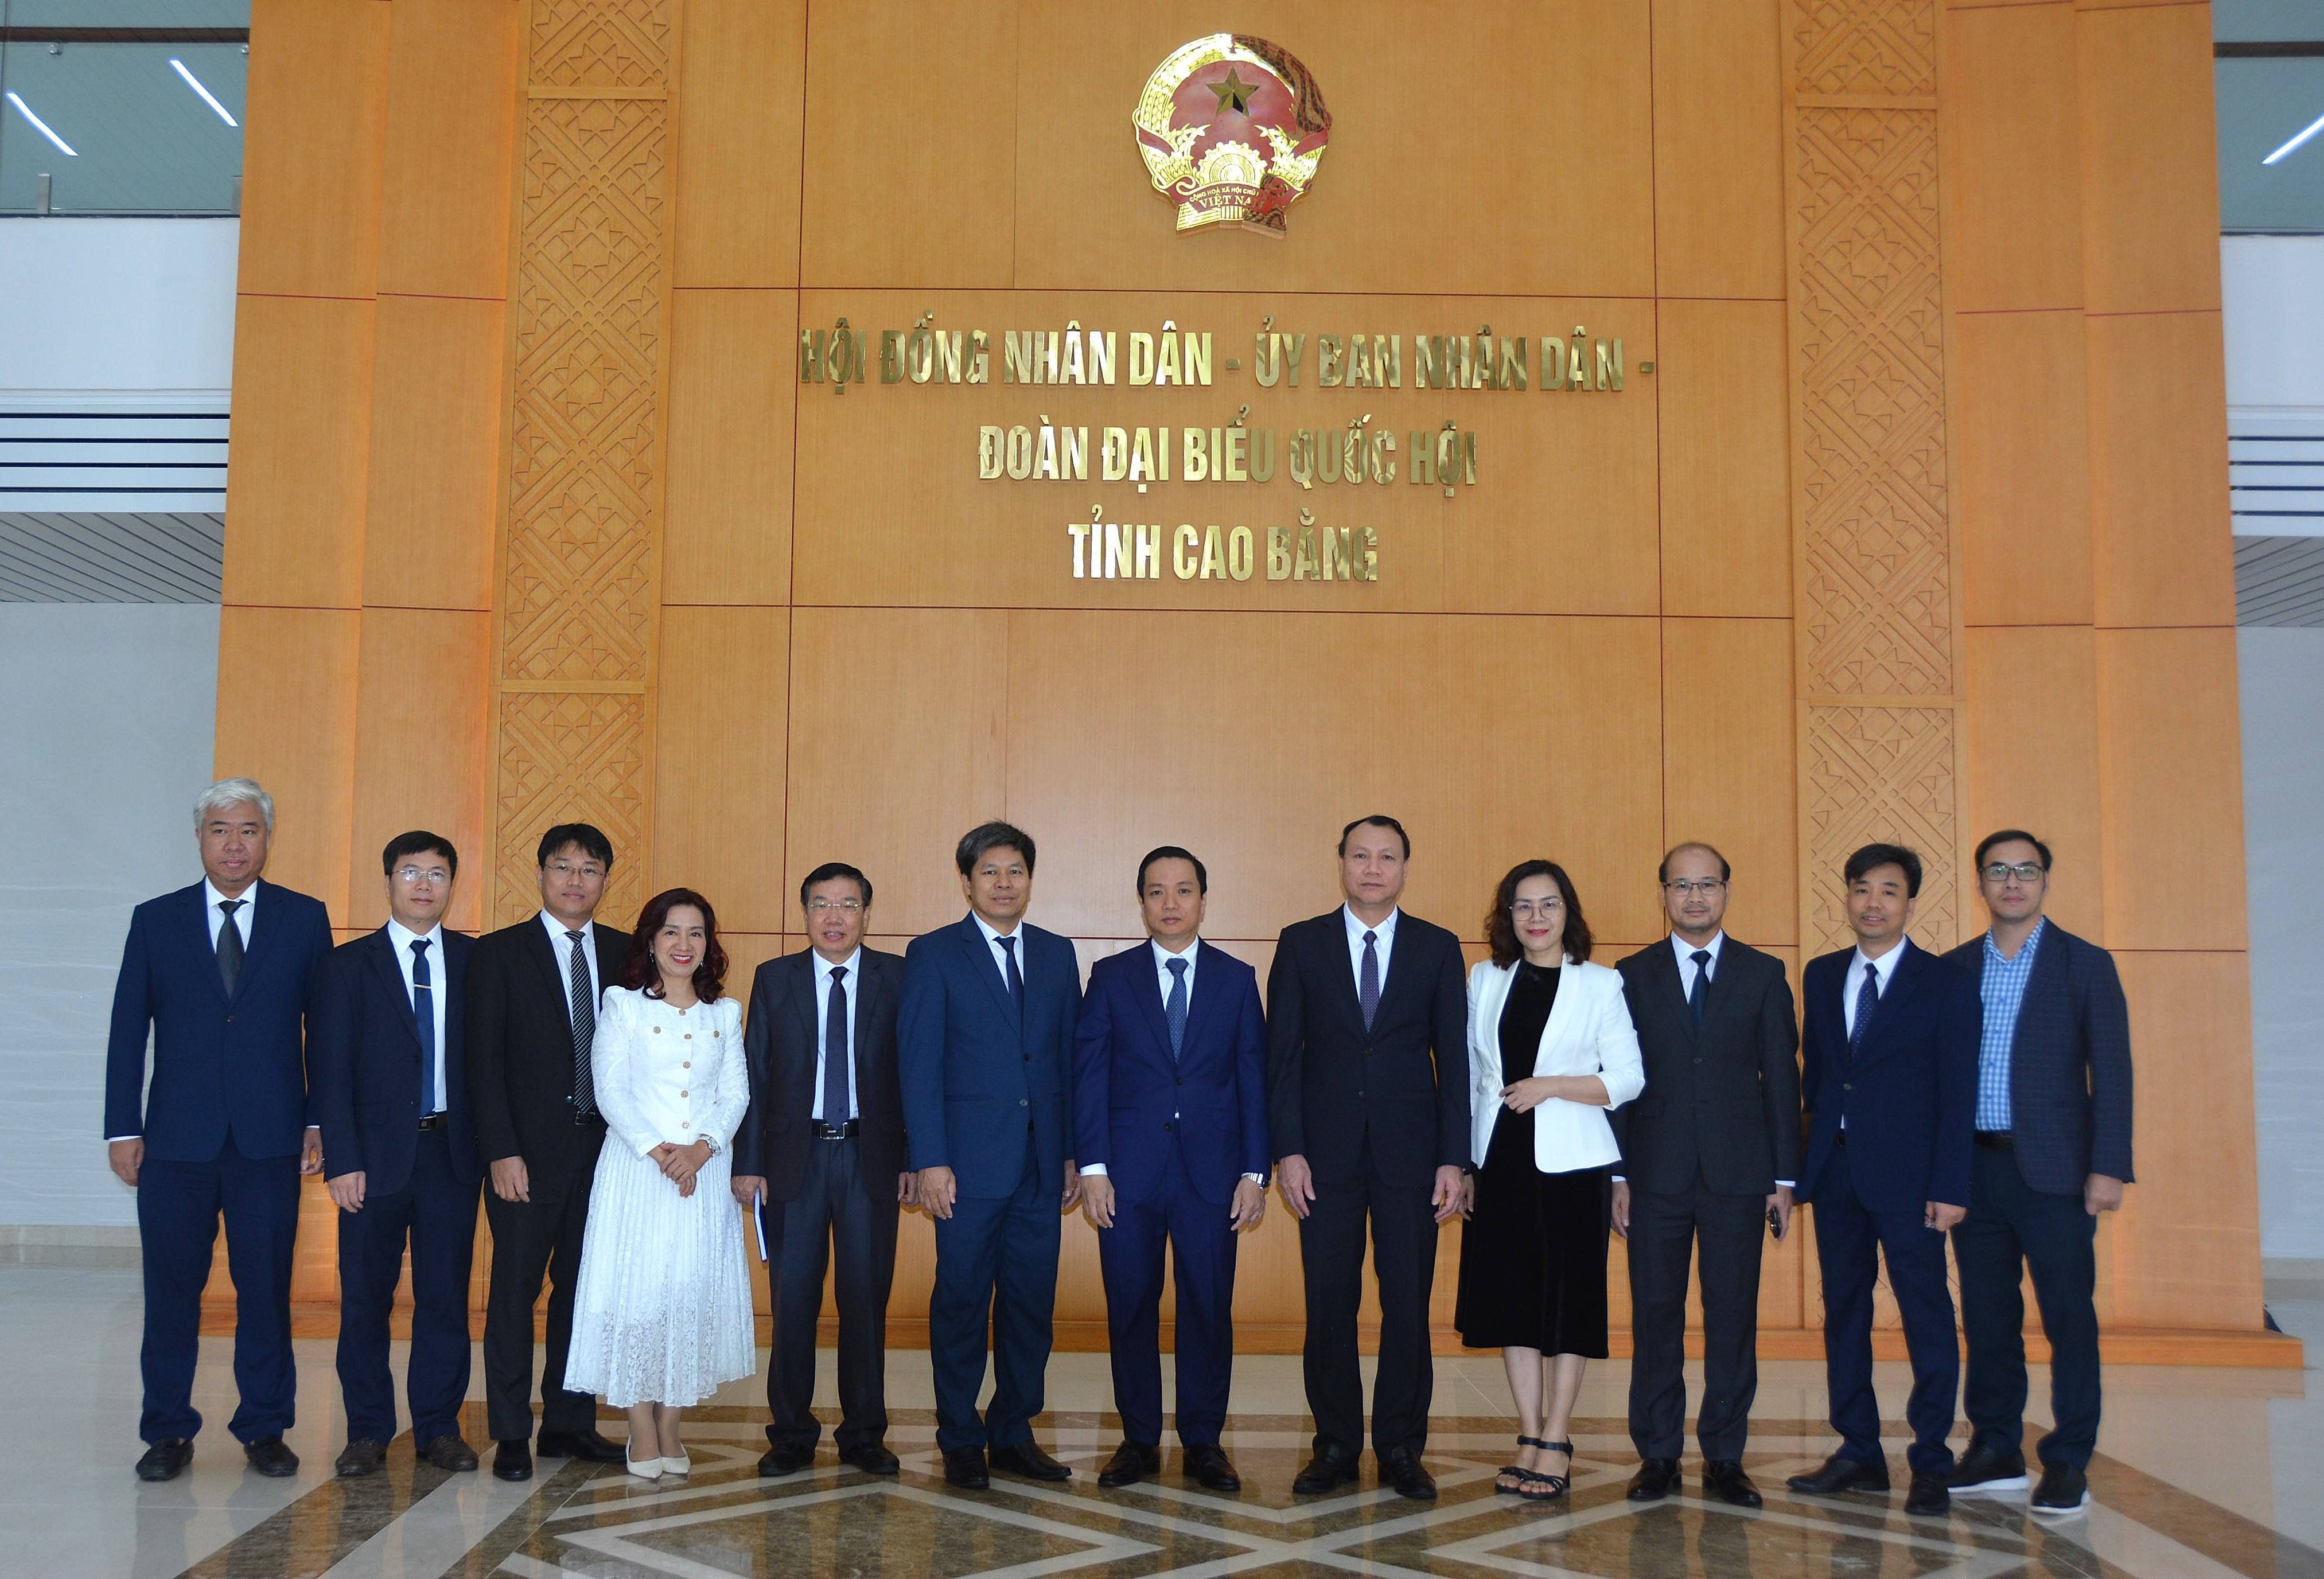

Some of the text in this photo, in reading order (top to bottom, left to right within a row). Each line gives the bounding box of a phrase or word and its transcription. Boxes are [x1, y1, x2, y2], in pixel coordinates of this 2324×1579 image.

[1198, 193, 1231, 208] VIỆT
[801, 317, 866, 395] HỘI
[880, 310, 990, 384] ĐỒNG
[1004, 320, 1116, 385] NHÂN
[1129, 320, 1212, 385] DÂN
[1255, 314, 1305, 387] ỦY
[1319, 334, 1401, 388] BAN
[1415, 324, 1528, 391] NHÂN
[1540, 326, 1624, 391] DÂN
[978, 404, 1476, 498] ĐOÀN ĐẠI BIỂU QUỐC HỘI
[1068, 504, 1377, 582] TỈNH CAO BẰNG
